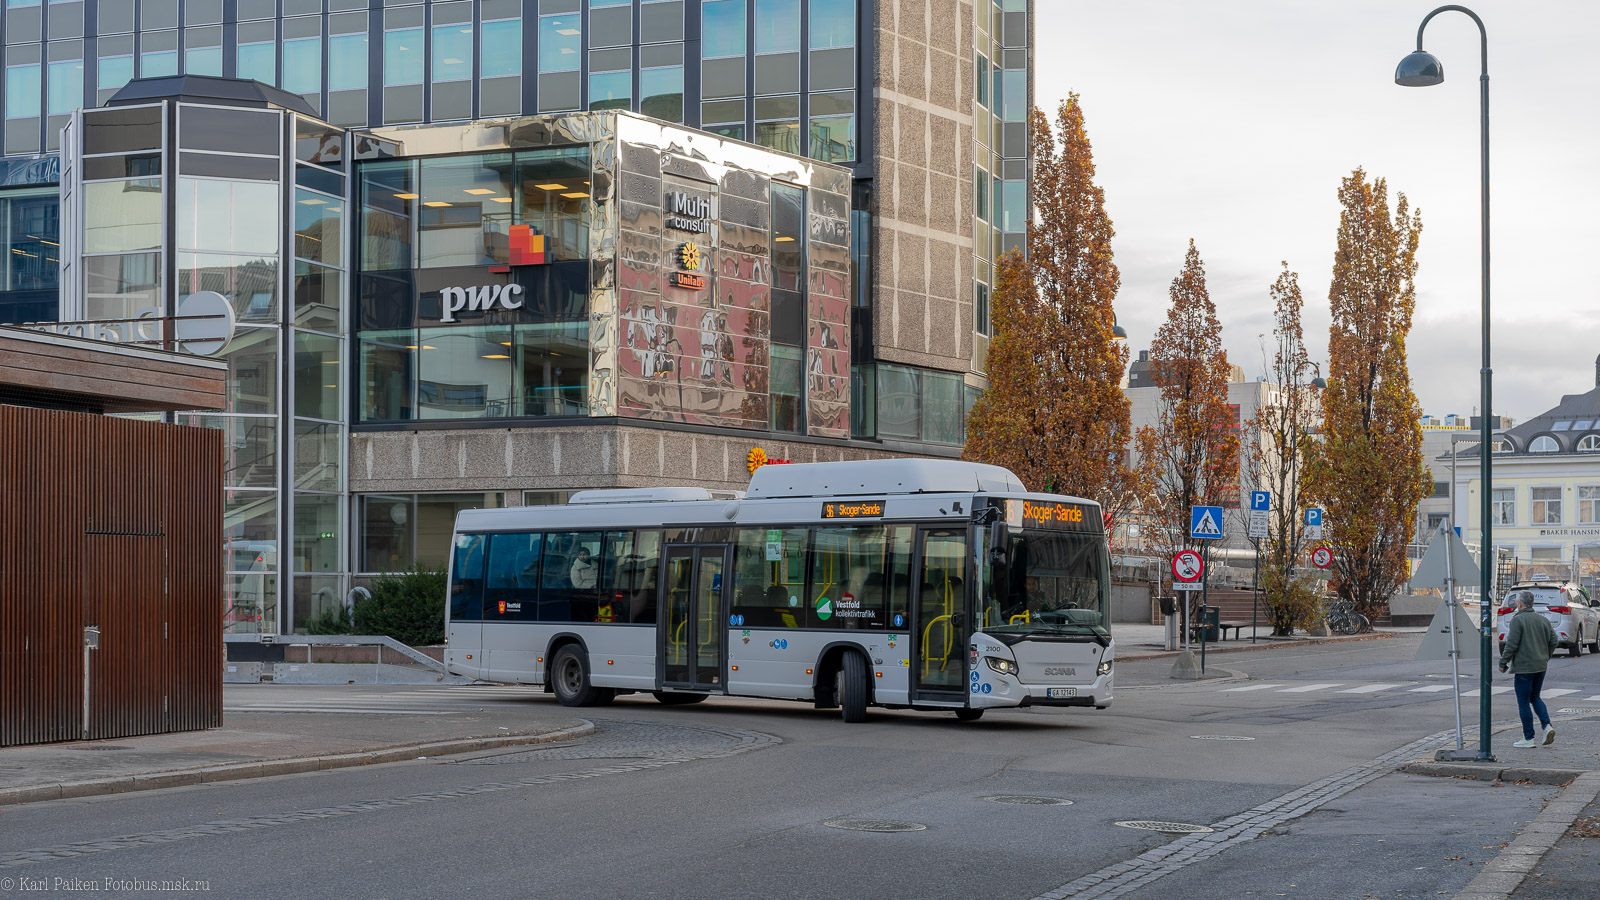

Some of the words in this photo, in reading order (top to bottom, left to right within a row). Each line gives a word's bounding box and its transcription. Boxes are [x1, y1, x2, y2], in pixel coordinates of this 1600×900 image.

[674, 190, 711, 219] Multi
[674, 217, 711, 234] consult
[677, 273, 705, 288] Unilabs
[439, 283, 522, 323] pwc
[1255, 493, 1266, 508] P
[838, 503, 881, 518] Skoger-Sande
[1023, 501, 1082, 524] Skoger-Sande
[1308, 510, 1318, 524] P
[835, 600, 861, 609] Vestfold
[835, 609, 876, 619] kollektivtrafikk
[1044, 667, 1077, 676] SCANIA
[1052, 689, 1060, 697] GA
